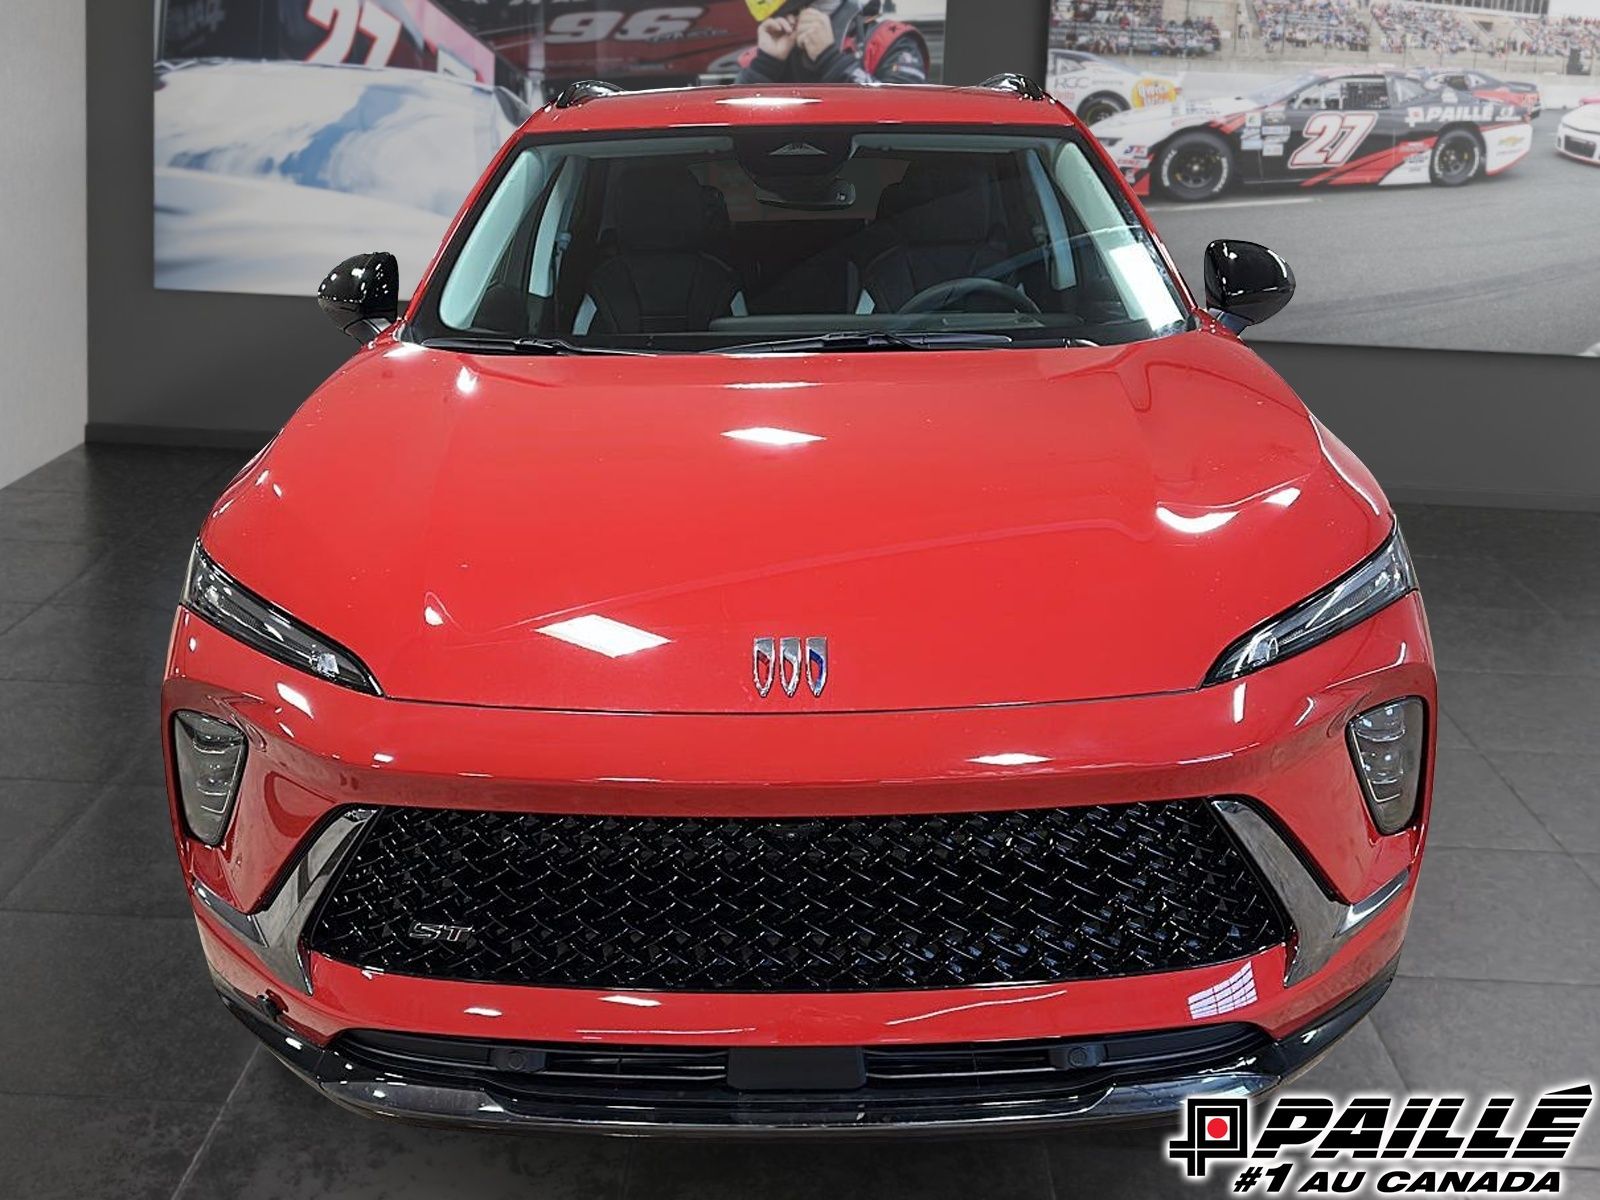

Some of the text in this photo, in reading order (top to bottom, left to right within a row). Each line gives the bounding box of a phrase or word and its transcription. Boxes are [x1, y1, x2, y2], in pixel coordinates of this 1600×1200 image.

[543, 6, 704, 43] 96
[1288, 110, 1378, 169] 27
[409, 922, 474, 941] ST
